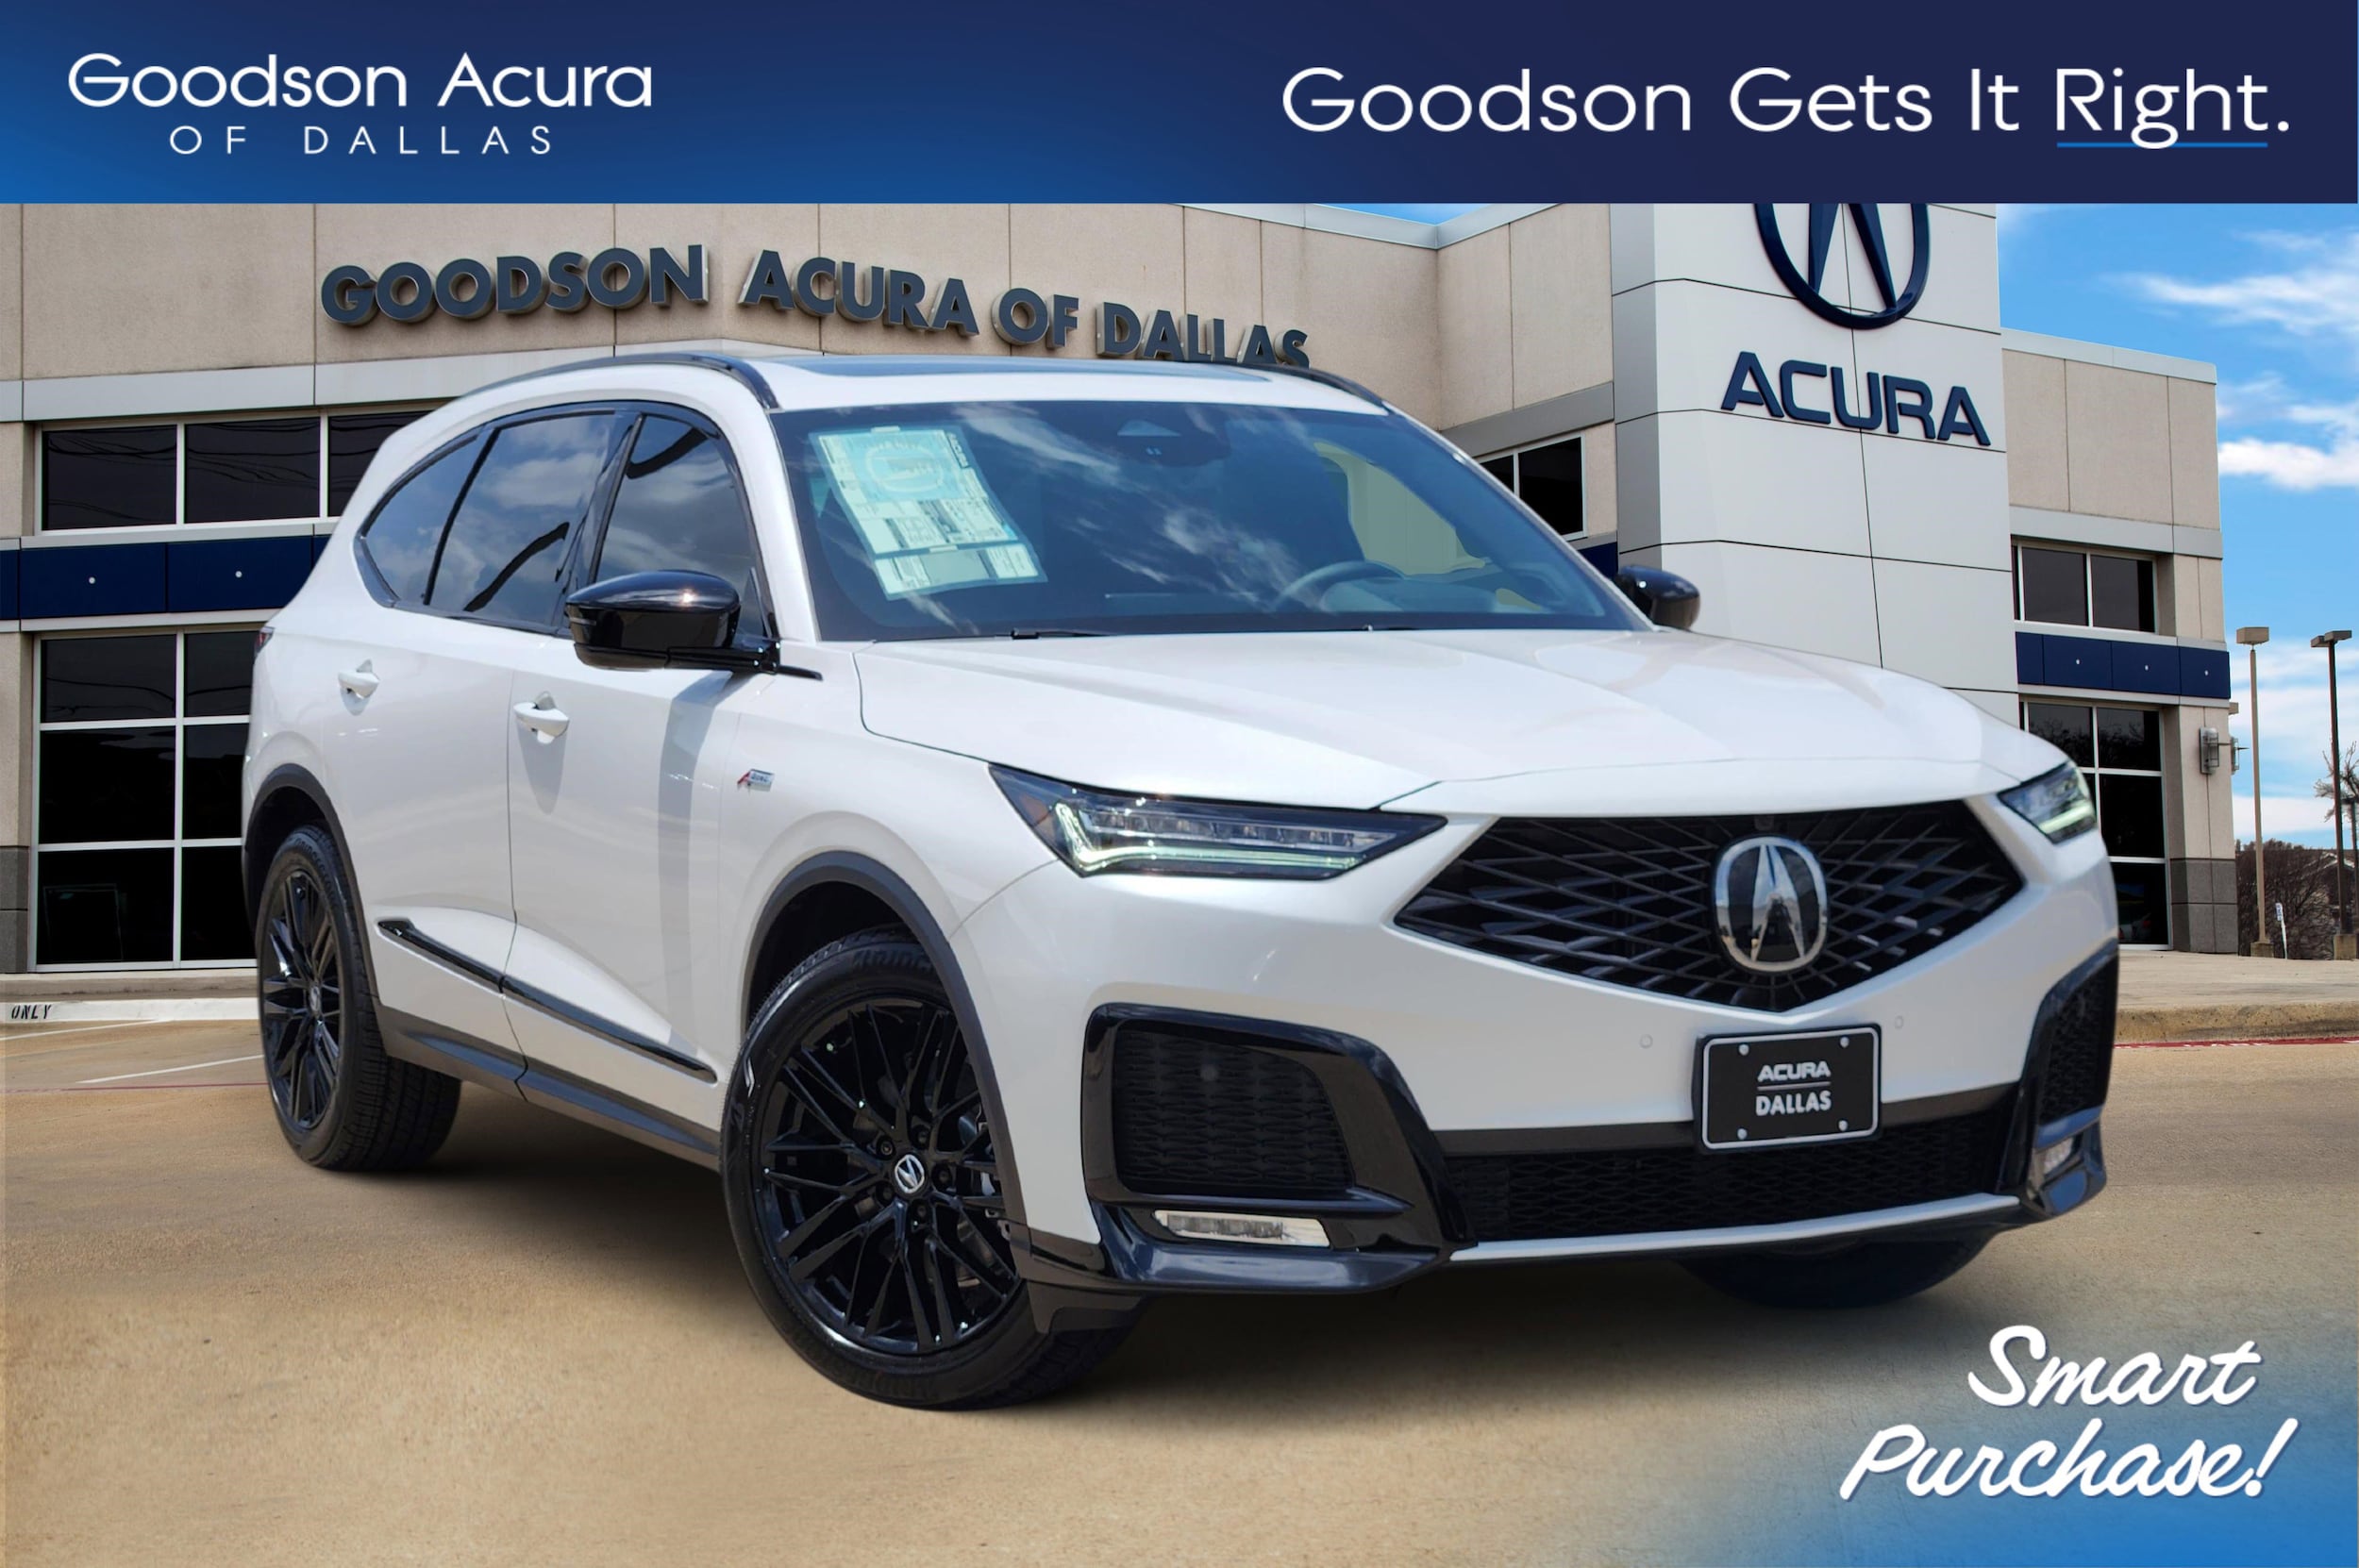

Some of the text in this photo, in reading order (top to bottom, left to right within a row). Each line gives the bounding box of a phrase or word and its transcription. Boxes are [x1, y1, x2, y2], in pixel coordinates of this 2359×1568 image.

[321, 243, 1310, 369] GOODSON ACURA OF DALLAS
[1720, 351, 1991, 446] ACURA
[11, 1004, 52, 1020] ONLY
[1757, 1060, 1832, 1082] ACURA
[1755, 1090, 1832, 1116] DALLAS
